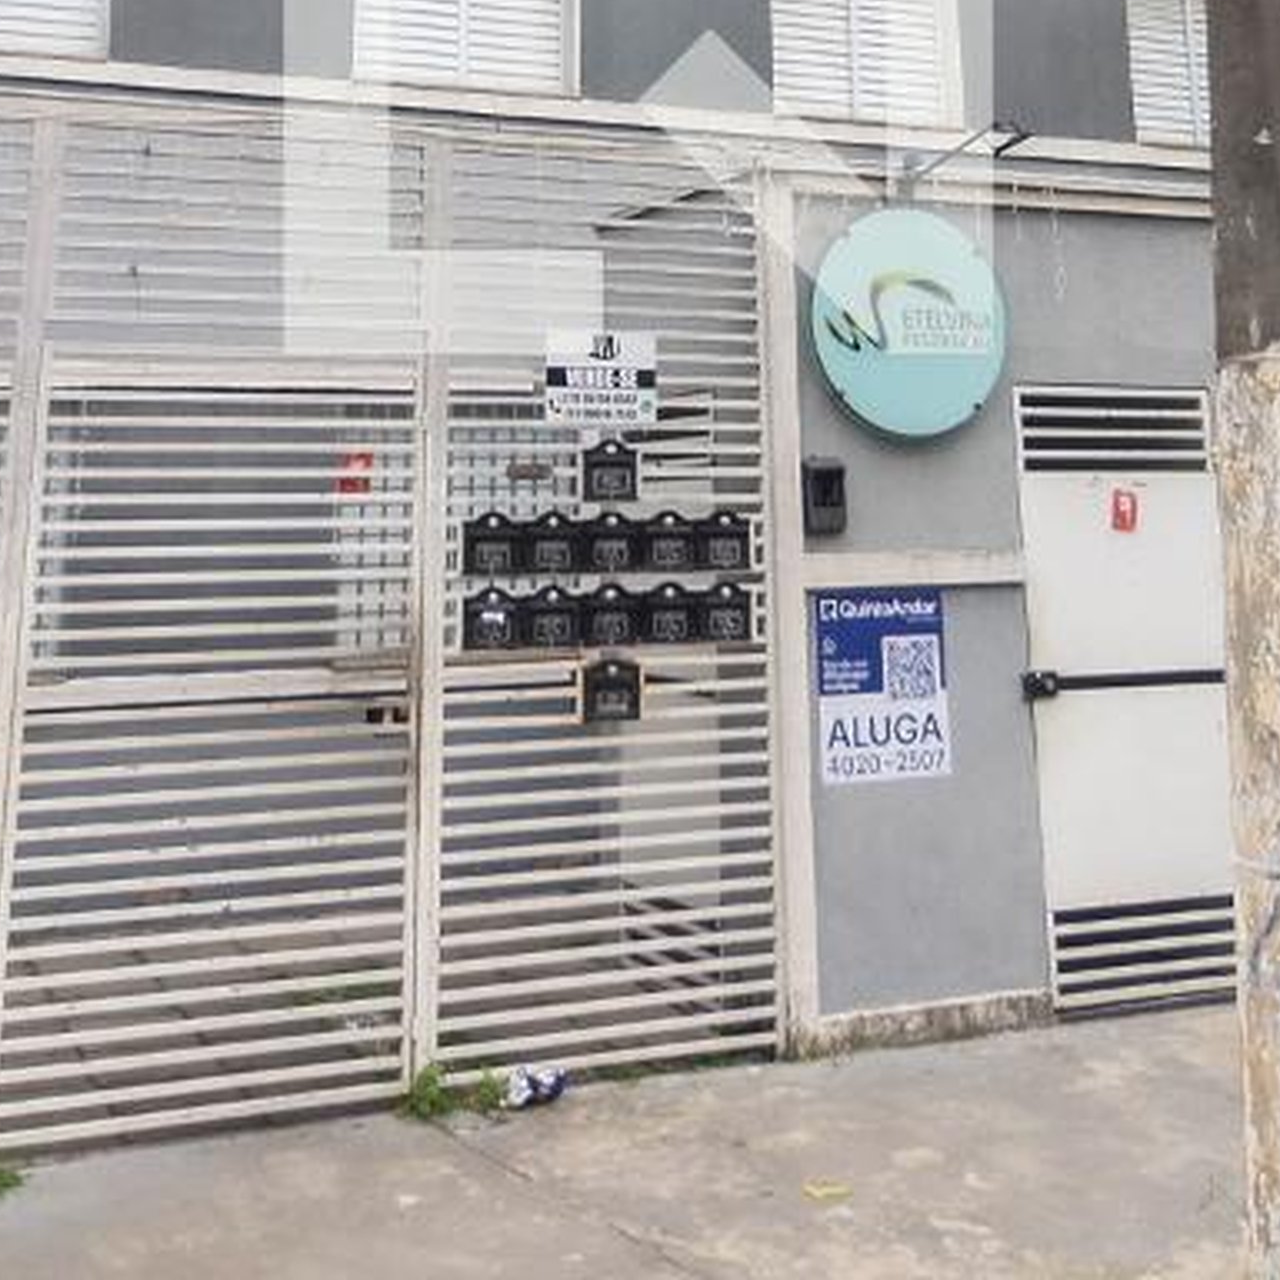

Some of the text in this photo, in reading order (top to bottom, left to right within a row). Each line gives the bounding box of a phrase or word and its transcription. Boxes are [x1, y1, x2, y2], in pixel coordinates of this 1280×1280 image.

[839, 597, 939, 620] QuintoAndar
[827, 711, 945, 750] ALUGA
[826, 749, 946, 776] 4020-2507
